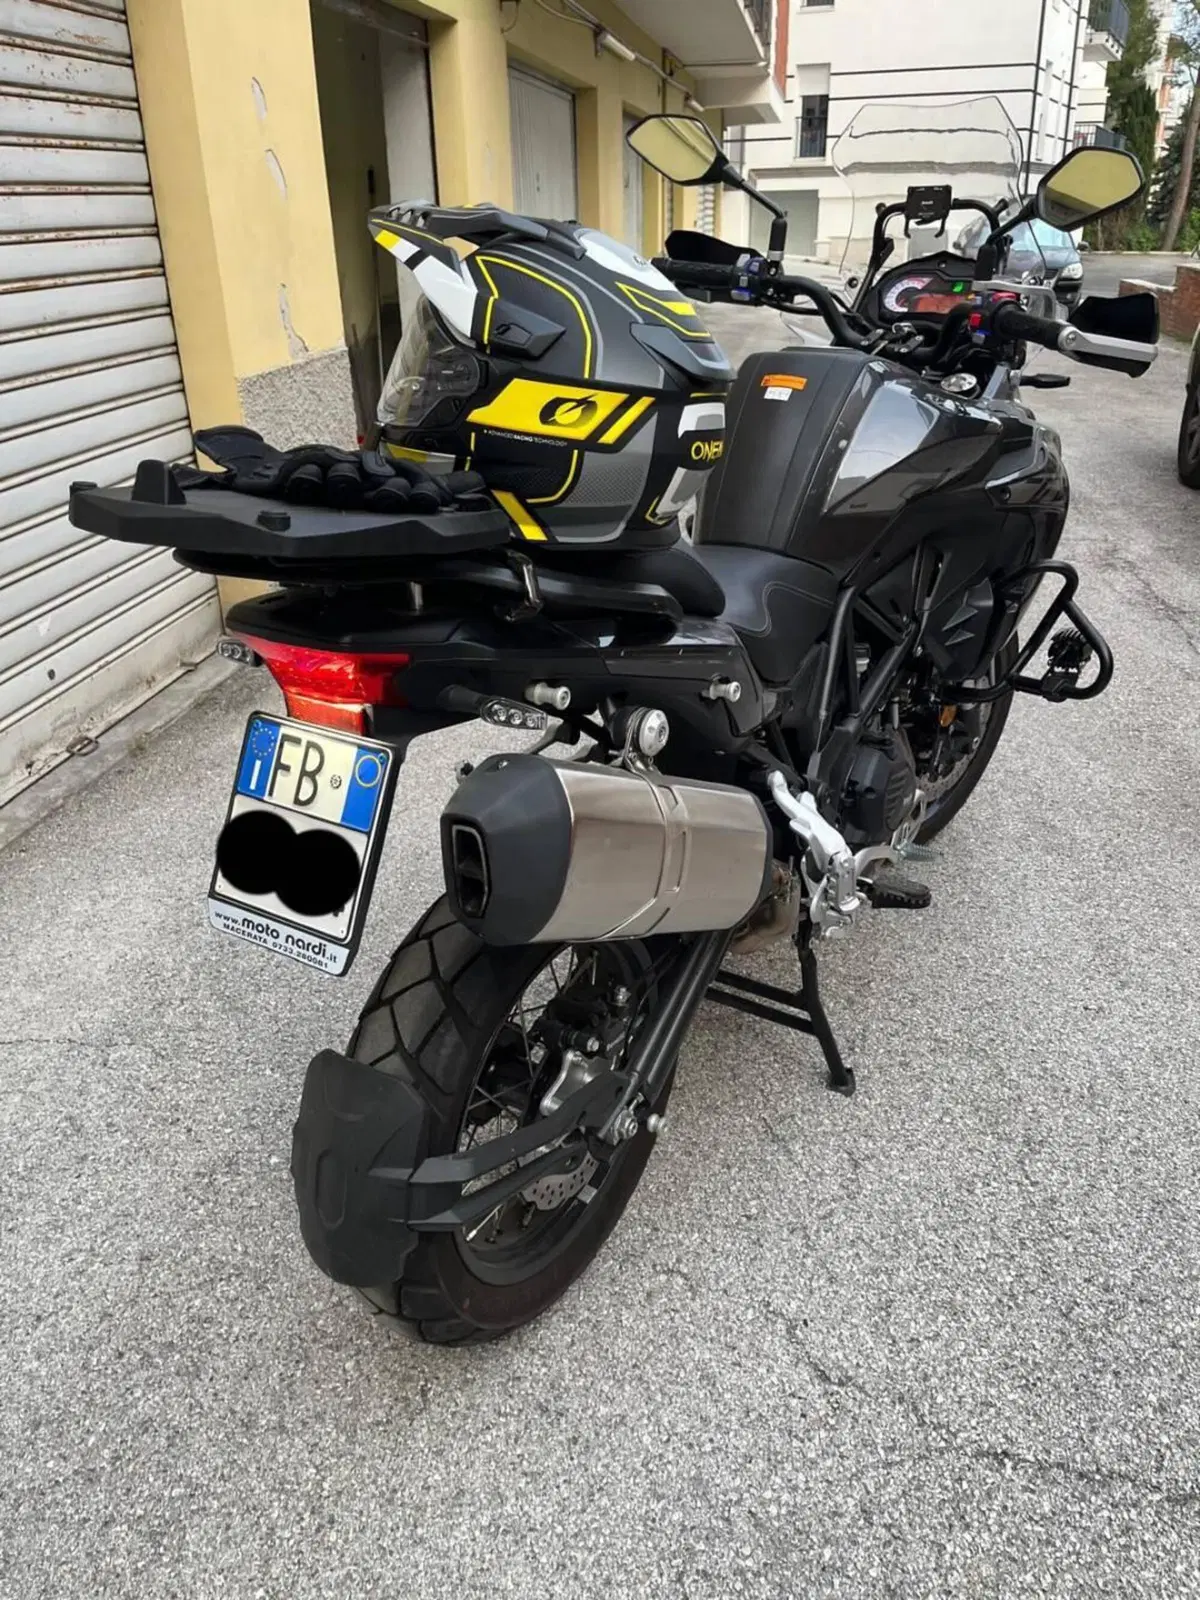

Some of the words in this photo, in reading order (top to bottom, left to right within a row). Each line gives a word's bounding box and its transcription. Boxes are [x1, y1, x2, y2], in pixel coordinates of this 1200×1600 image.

[514, 434, 533, 443] RACING
[268, 733, 325, 807] FB
[223, 922, 268, 945] MACERATA
[285, 934, 337, 963] nardi.it
